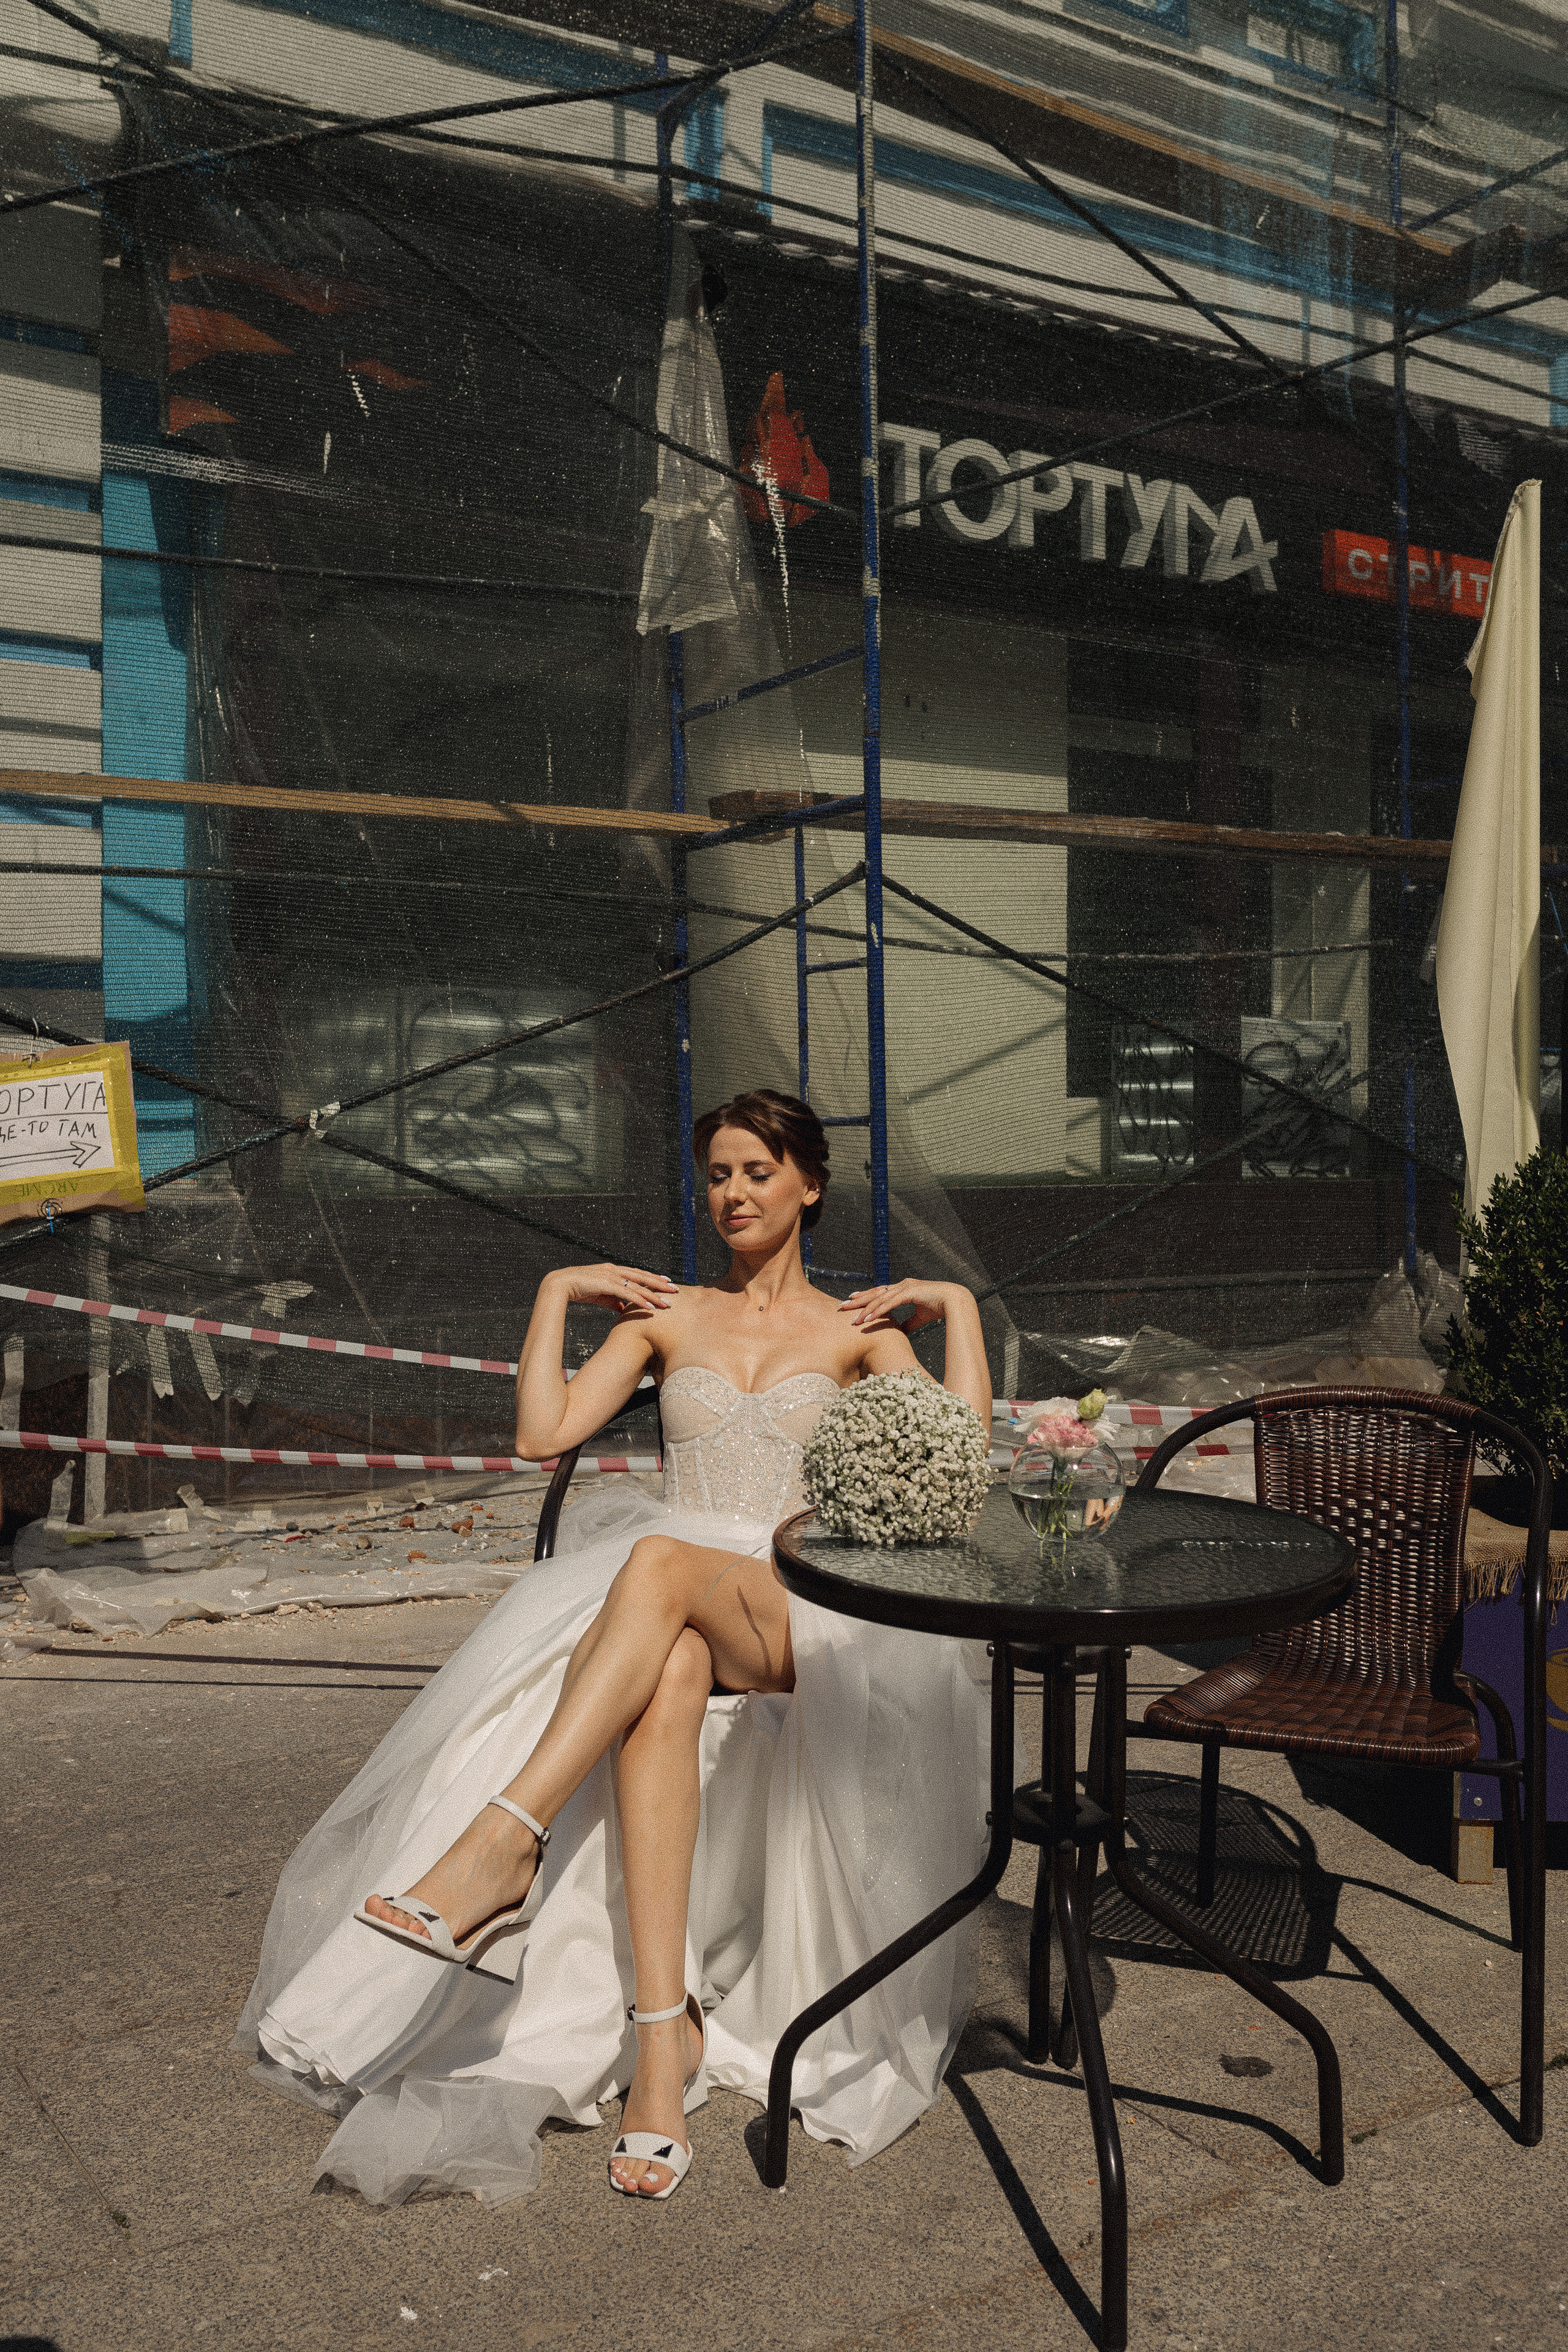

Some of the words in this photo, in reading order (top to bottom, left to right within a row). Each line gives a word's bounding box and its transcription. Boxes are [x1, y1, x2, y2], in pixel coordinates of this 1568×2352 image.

[878, 421, 1279, 593] ТОРТУГА
[1348, 548, 1490, 603] СТРИТ
[59, 1119, 97, 1139] ТАМ
